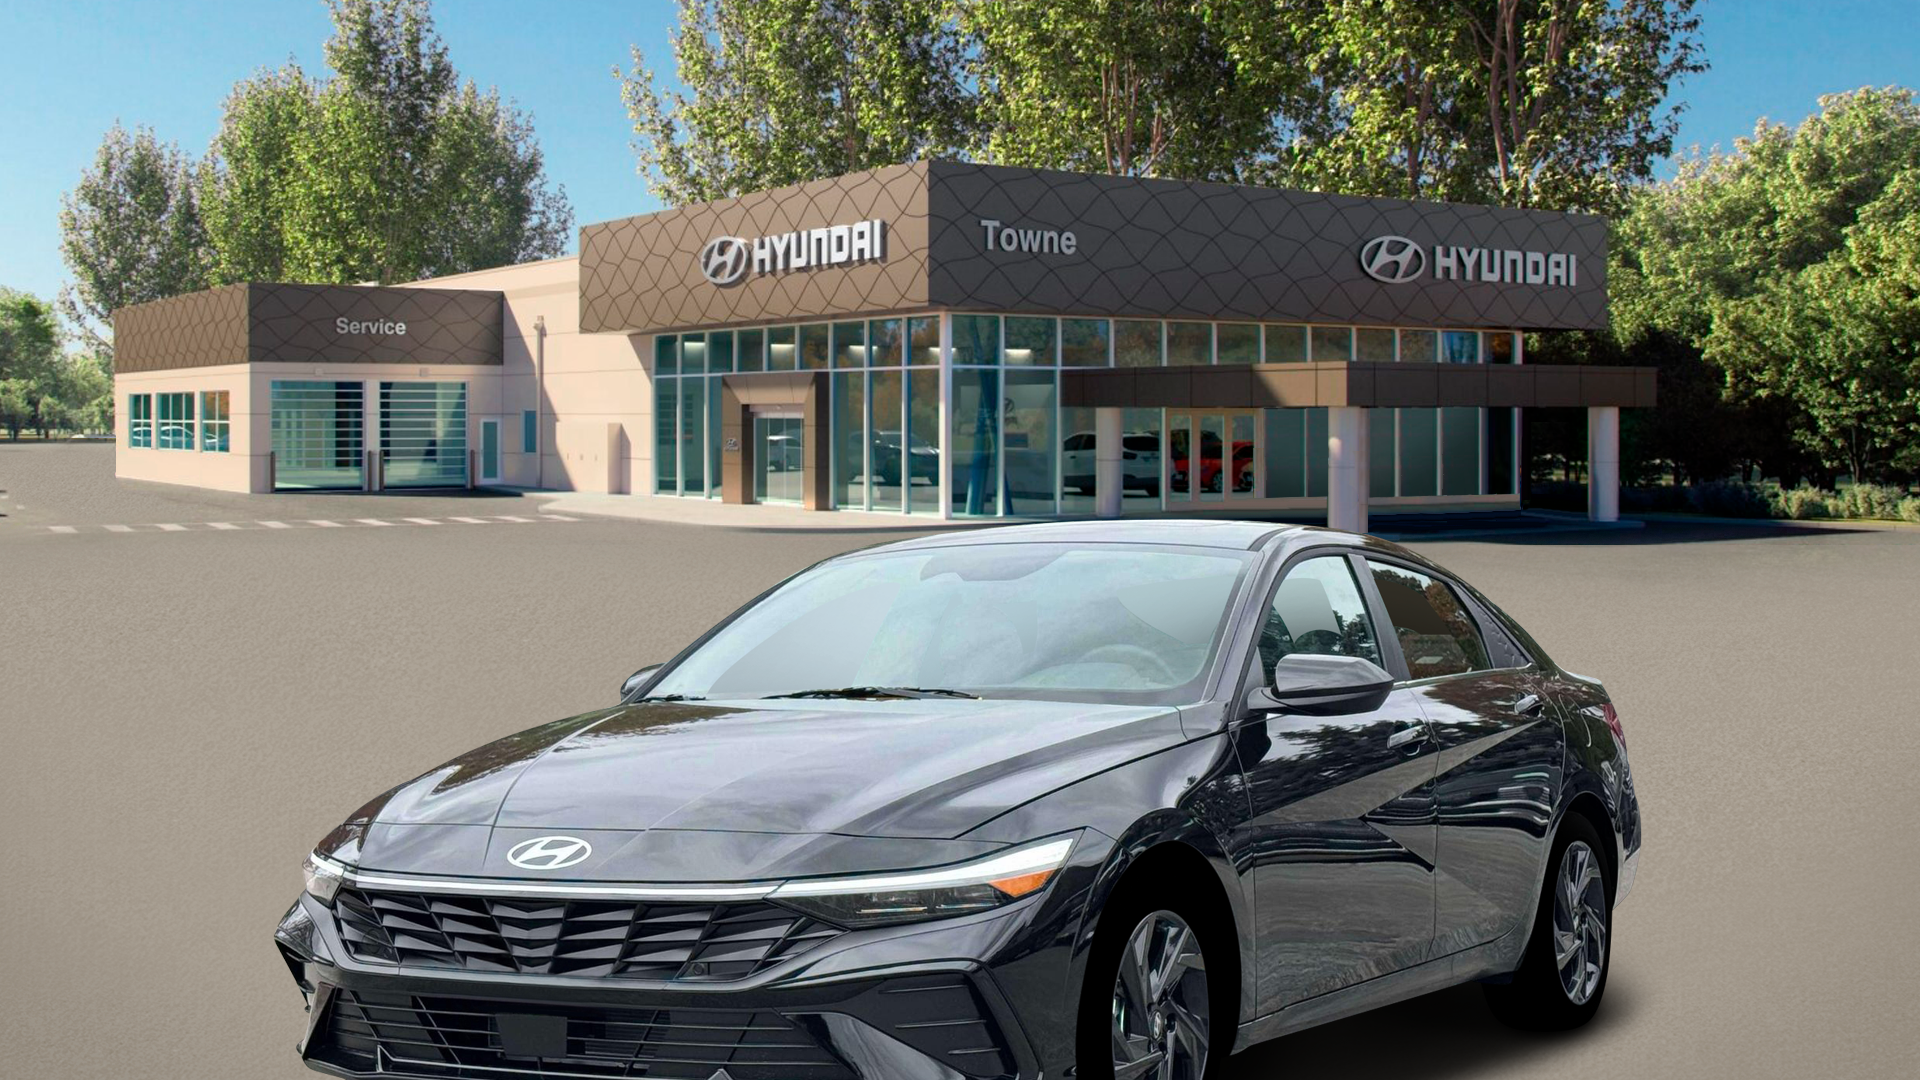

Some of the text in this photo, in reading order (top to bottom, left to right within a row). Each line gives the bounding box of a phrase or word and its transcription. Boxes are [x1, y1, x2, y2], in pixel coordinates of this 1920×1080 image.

[753, 219, 882, 273] HYUNDAI
[980, 219, 1077, 255] Towne
[1435, 245, 1576, 287] HYUNDAI
[335, 317, 407, 335] Service
